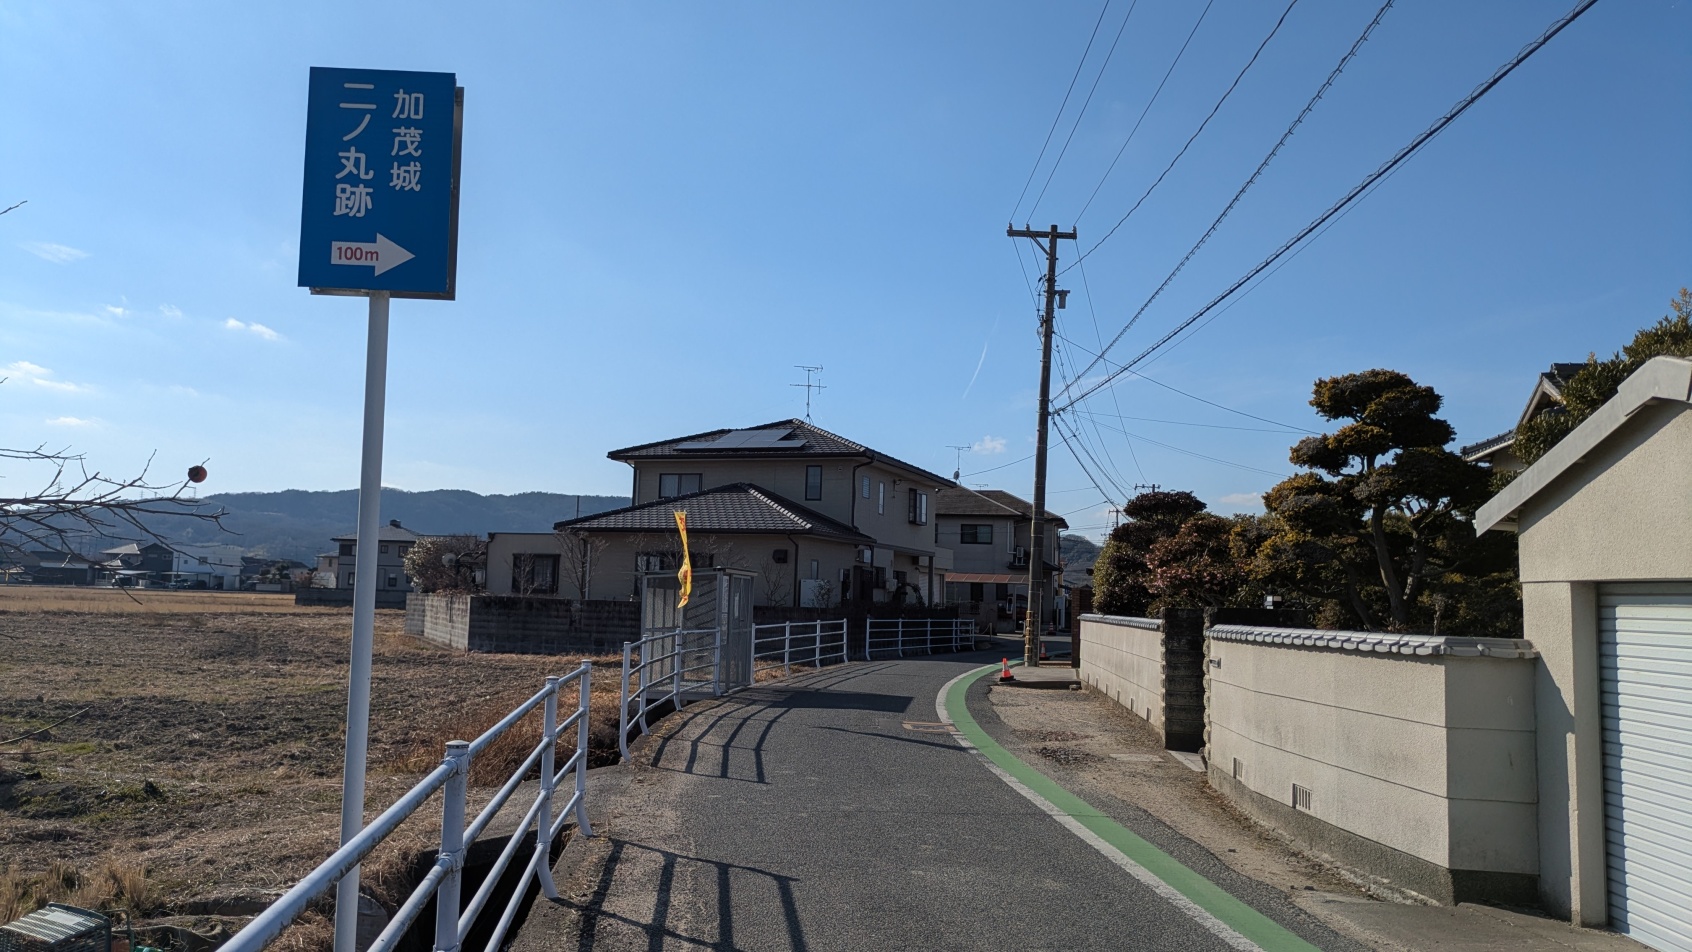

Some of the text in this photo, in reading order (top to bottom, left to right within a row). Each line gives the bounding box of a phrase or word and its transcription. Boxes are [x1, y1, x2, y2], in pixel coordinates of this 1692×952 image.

[333, 82, 377, 218] 二ノ丸跡
[389, 88, 424, 192] 加茂城
[336, 246, 379, 261] 100m
